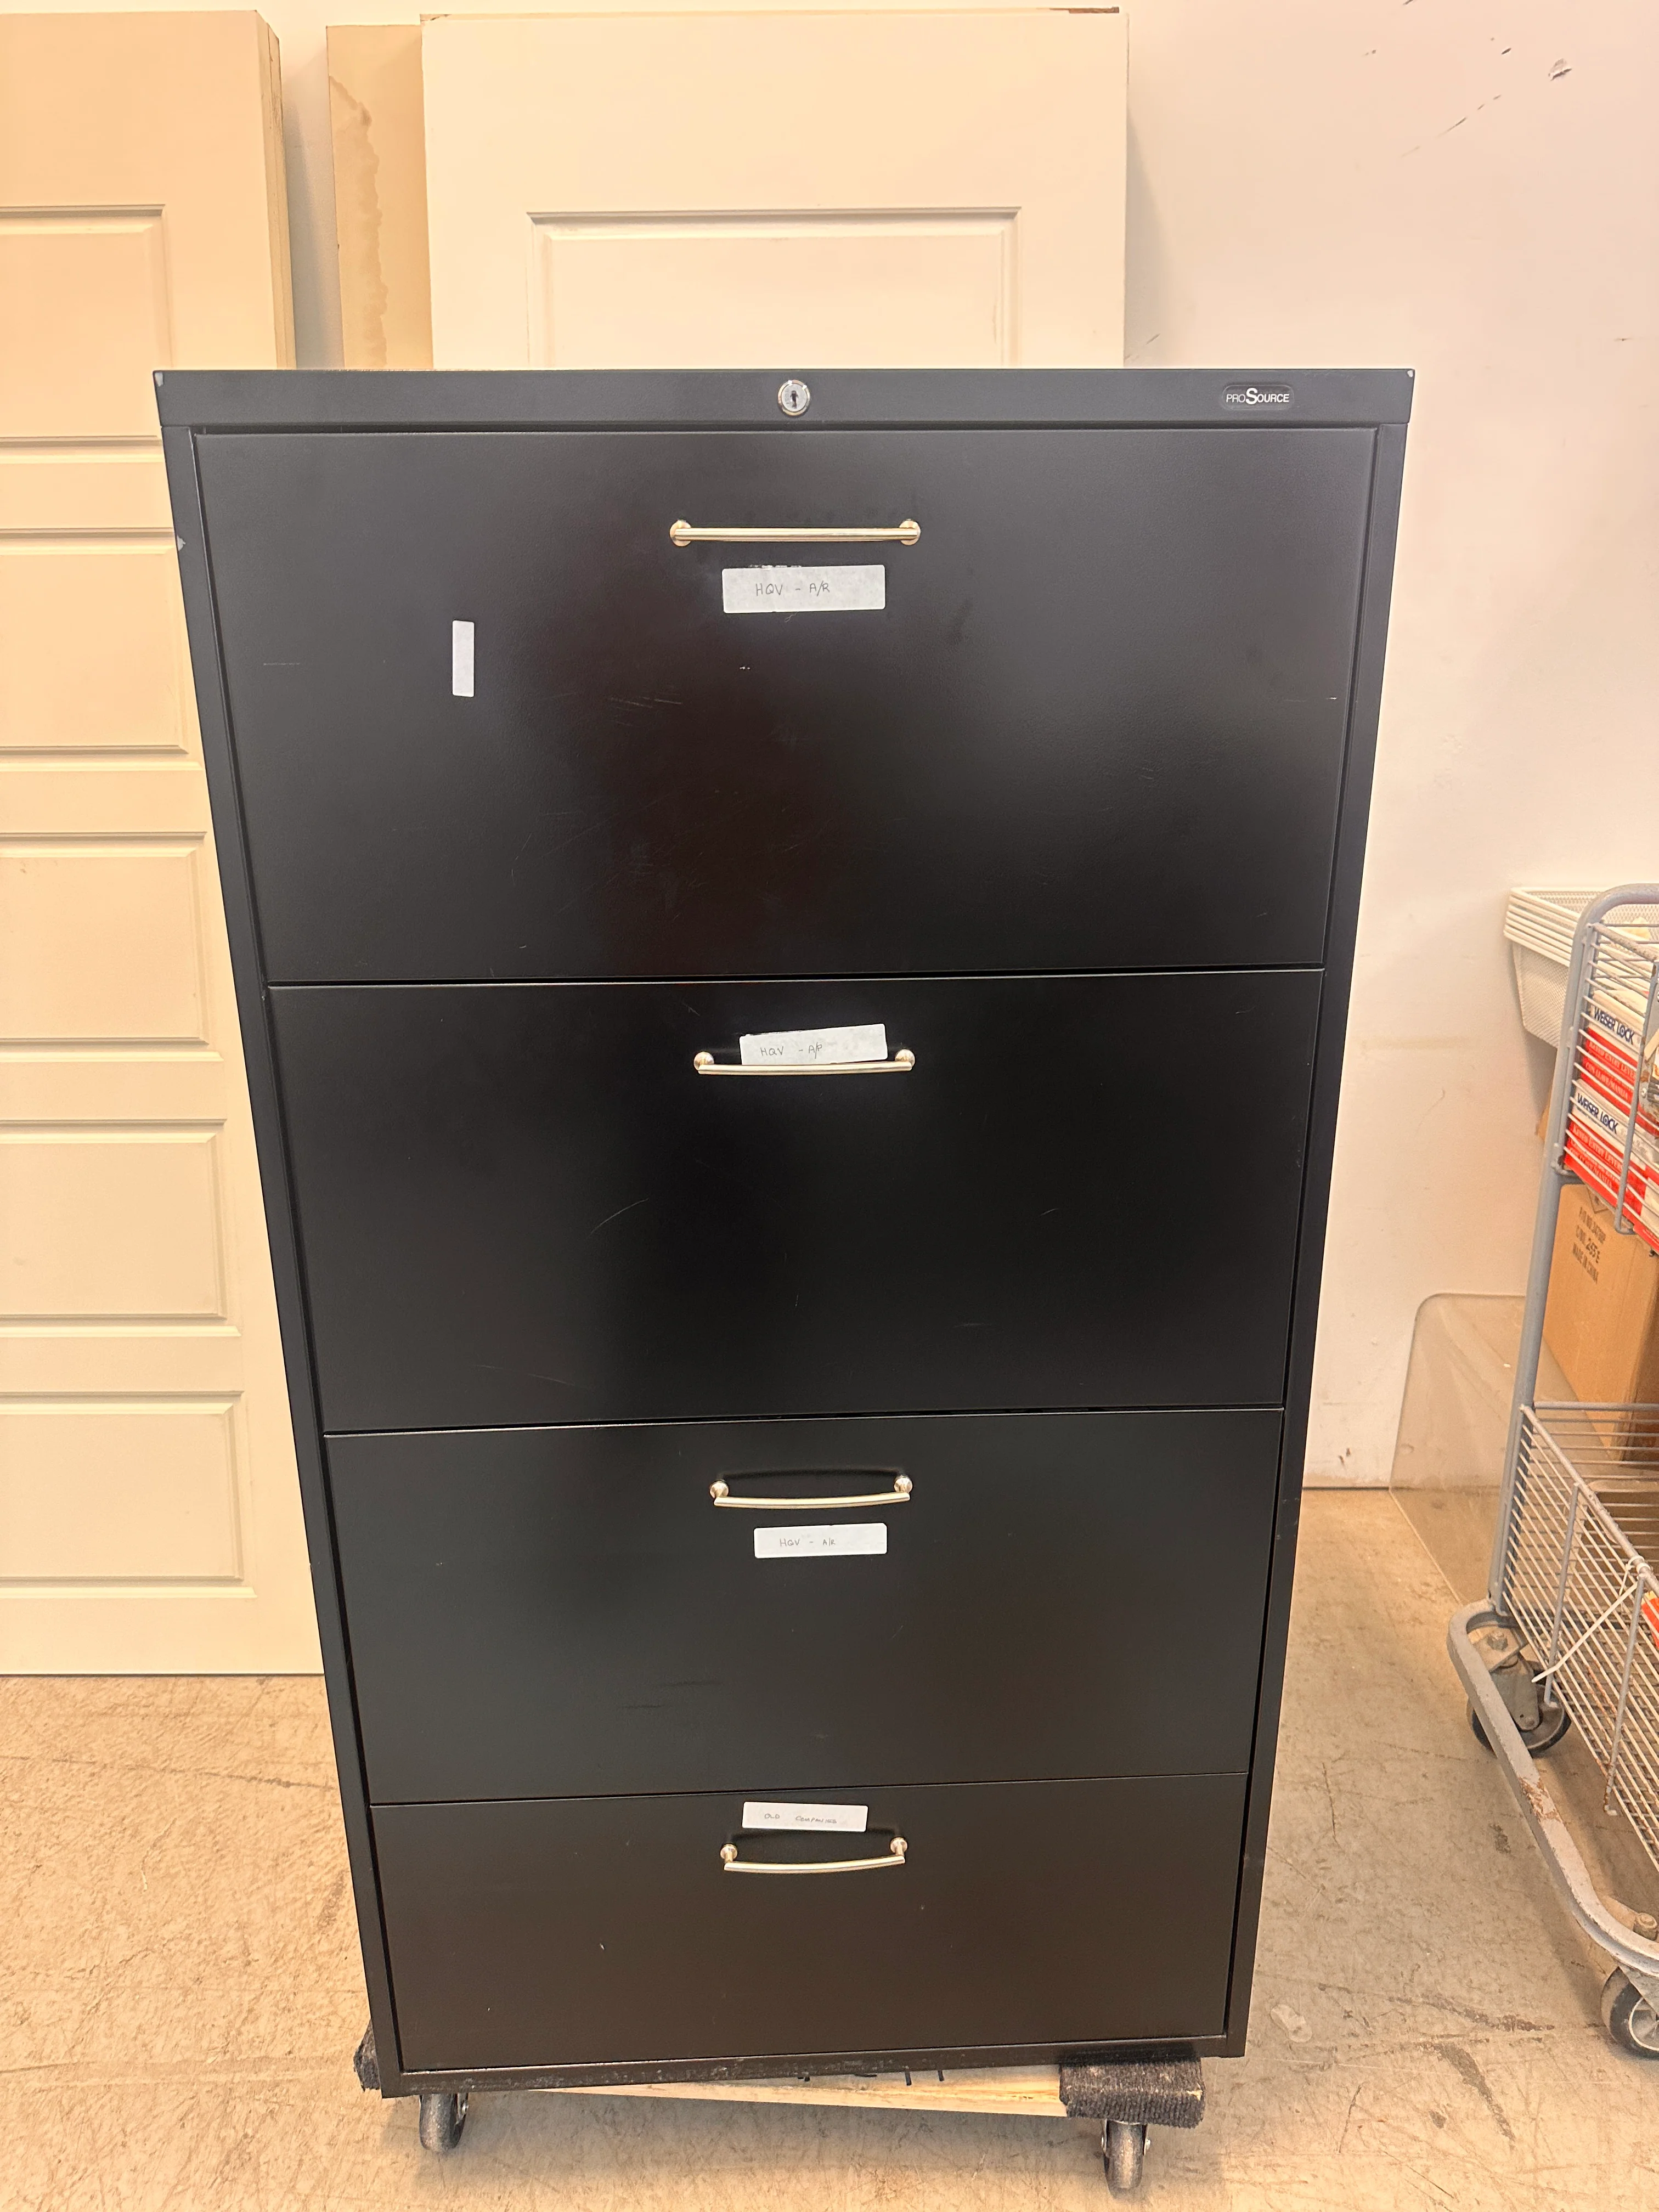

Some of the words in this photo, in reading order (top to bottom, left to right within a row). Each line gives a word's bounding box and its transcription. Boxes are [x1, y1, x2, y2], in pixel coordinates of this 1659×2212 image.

[1226, 387, 1290, 405] PROSOURCE
[809, 580, 830, 597] A/R
[1594, 1006, 1616, 1032] WEISER
[1617, 1021, 1635, 1045] LOCK
[1577, 1092, 1599, 1119] WEISER
[1600, 1111, 1618, 1135] LOCK
